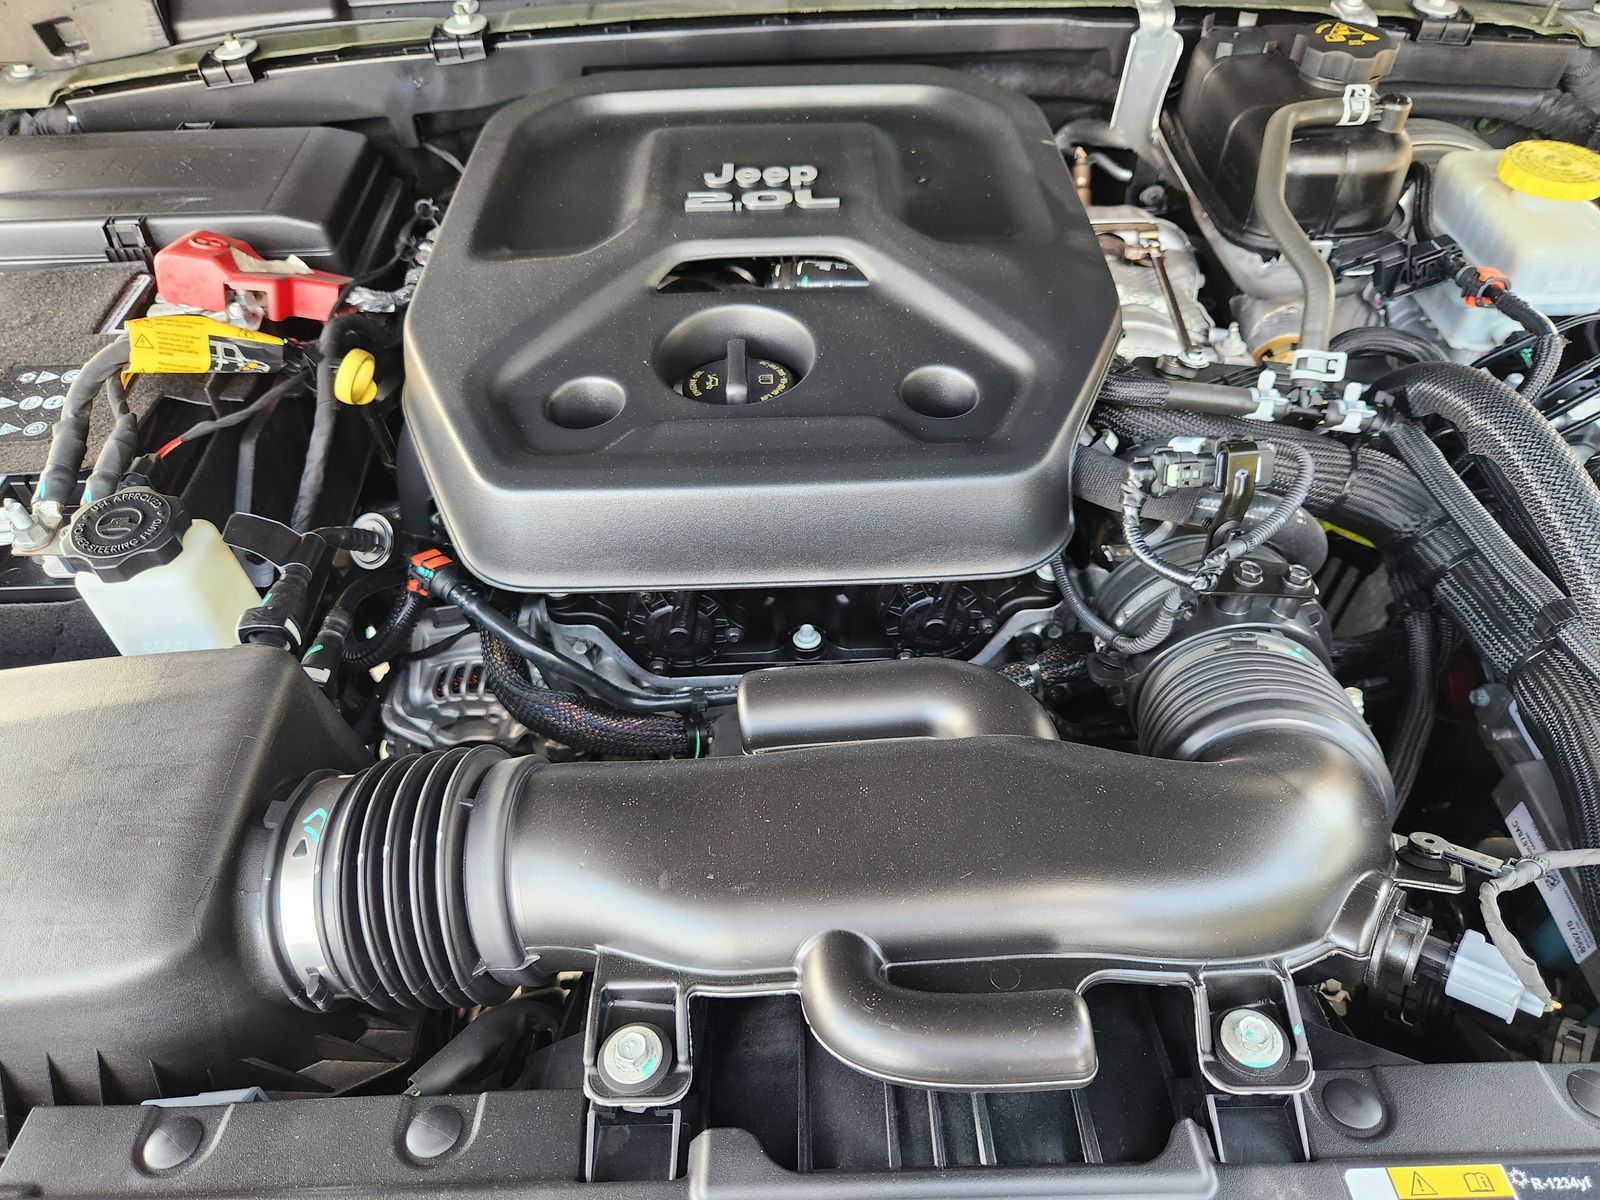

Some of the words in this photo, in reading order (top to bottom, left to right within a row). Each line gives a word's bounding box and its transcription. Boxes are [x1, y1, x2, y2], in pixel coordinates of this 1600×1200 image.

[703, 163, 818, 190] Jeep
[684, 189, 841, 213] 2.0L
[90, 500, 110, 512] USE
[113, 493, 161, 509] APPROVED
[140, 518, 162, 540] FLUID
[1530, 1176, 1593, 1192] R-1234yf
